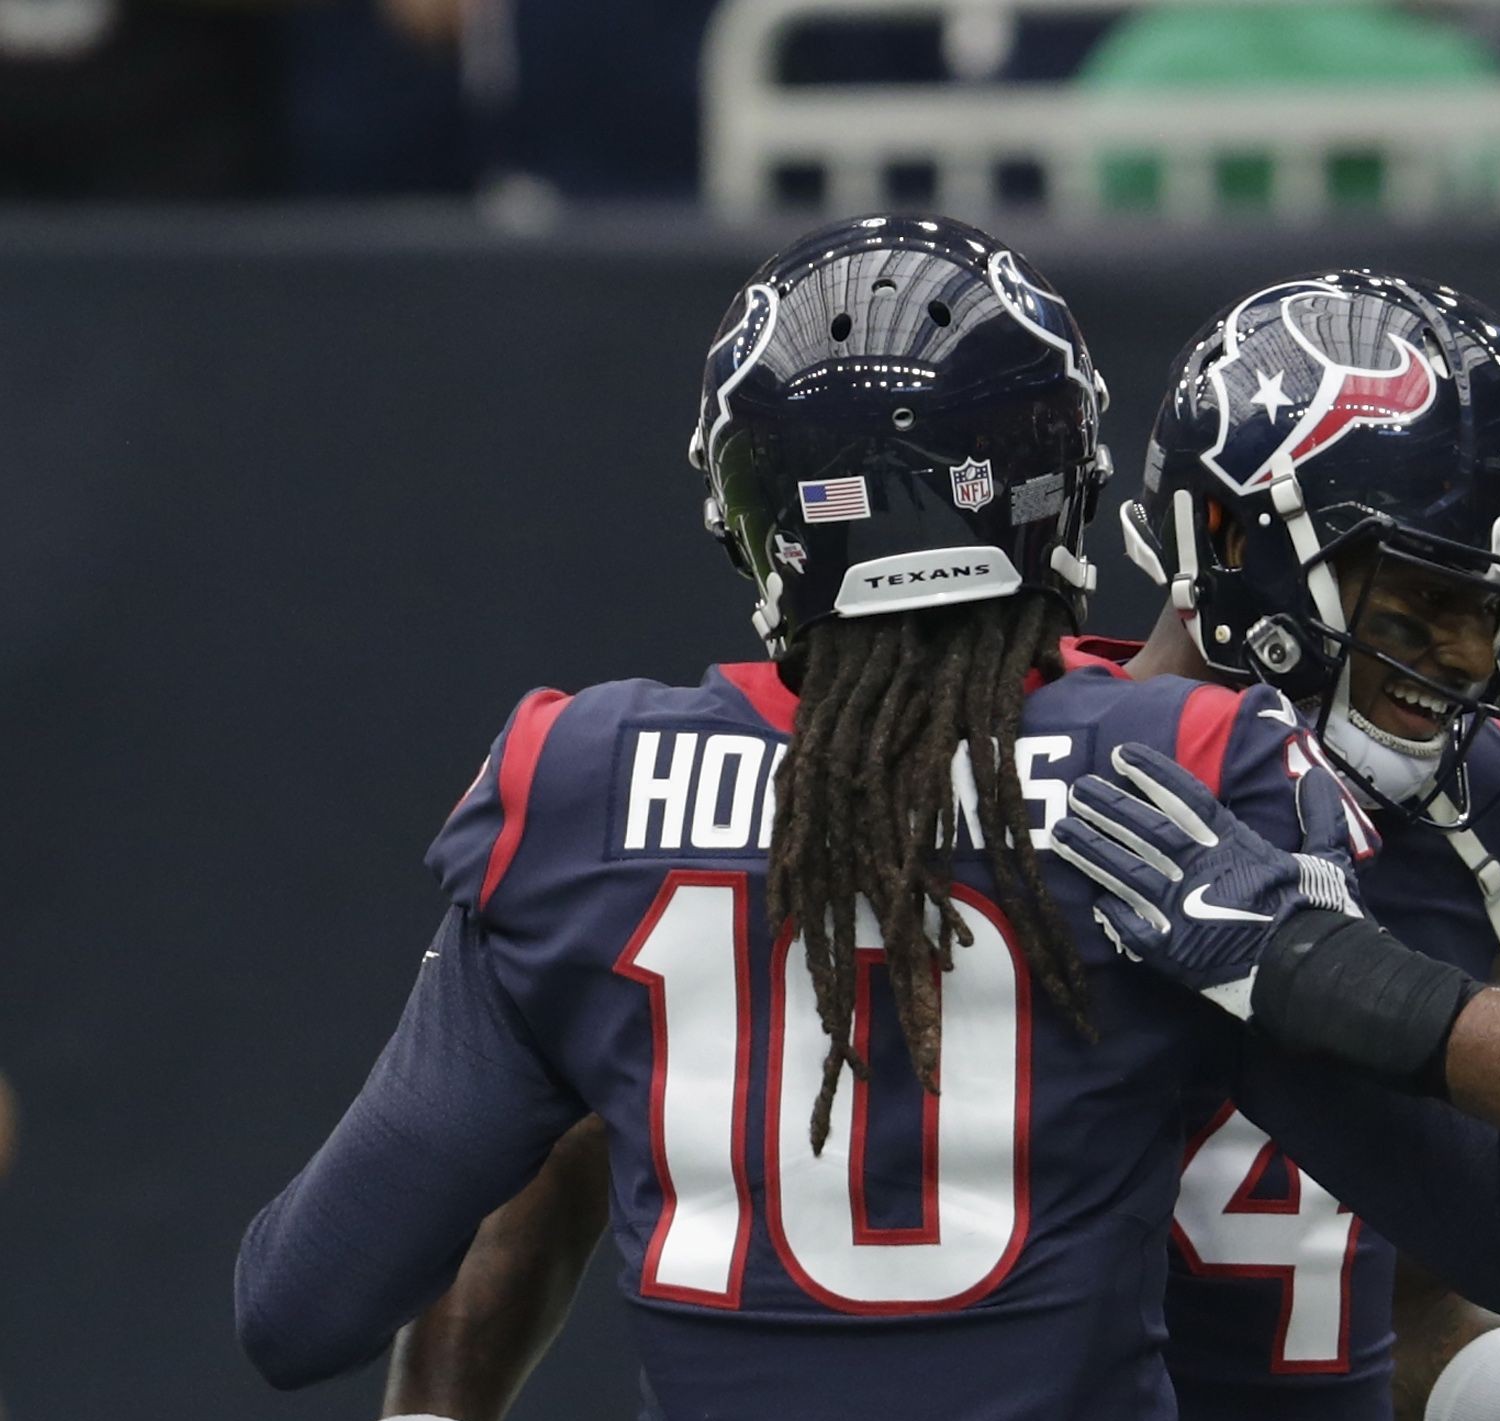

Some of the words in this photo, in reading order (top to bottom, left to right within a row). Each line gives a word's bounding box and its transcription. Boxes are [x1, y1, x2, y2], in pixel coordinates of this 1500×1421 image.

[959, 480, 991, 502] NFL
[864, 564, 990, 589] TEXANS
[613, 869, 1031, 1315] 10
[1170, 1099, 1362, 1374] 4
